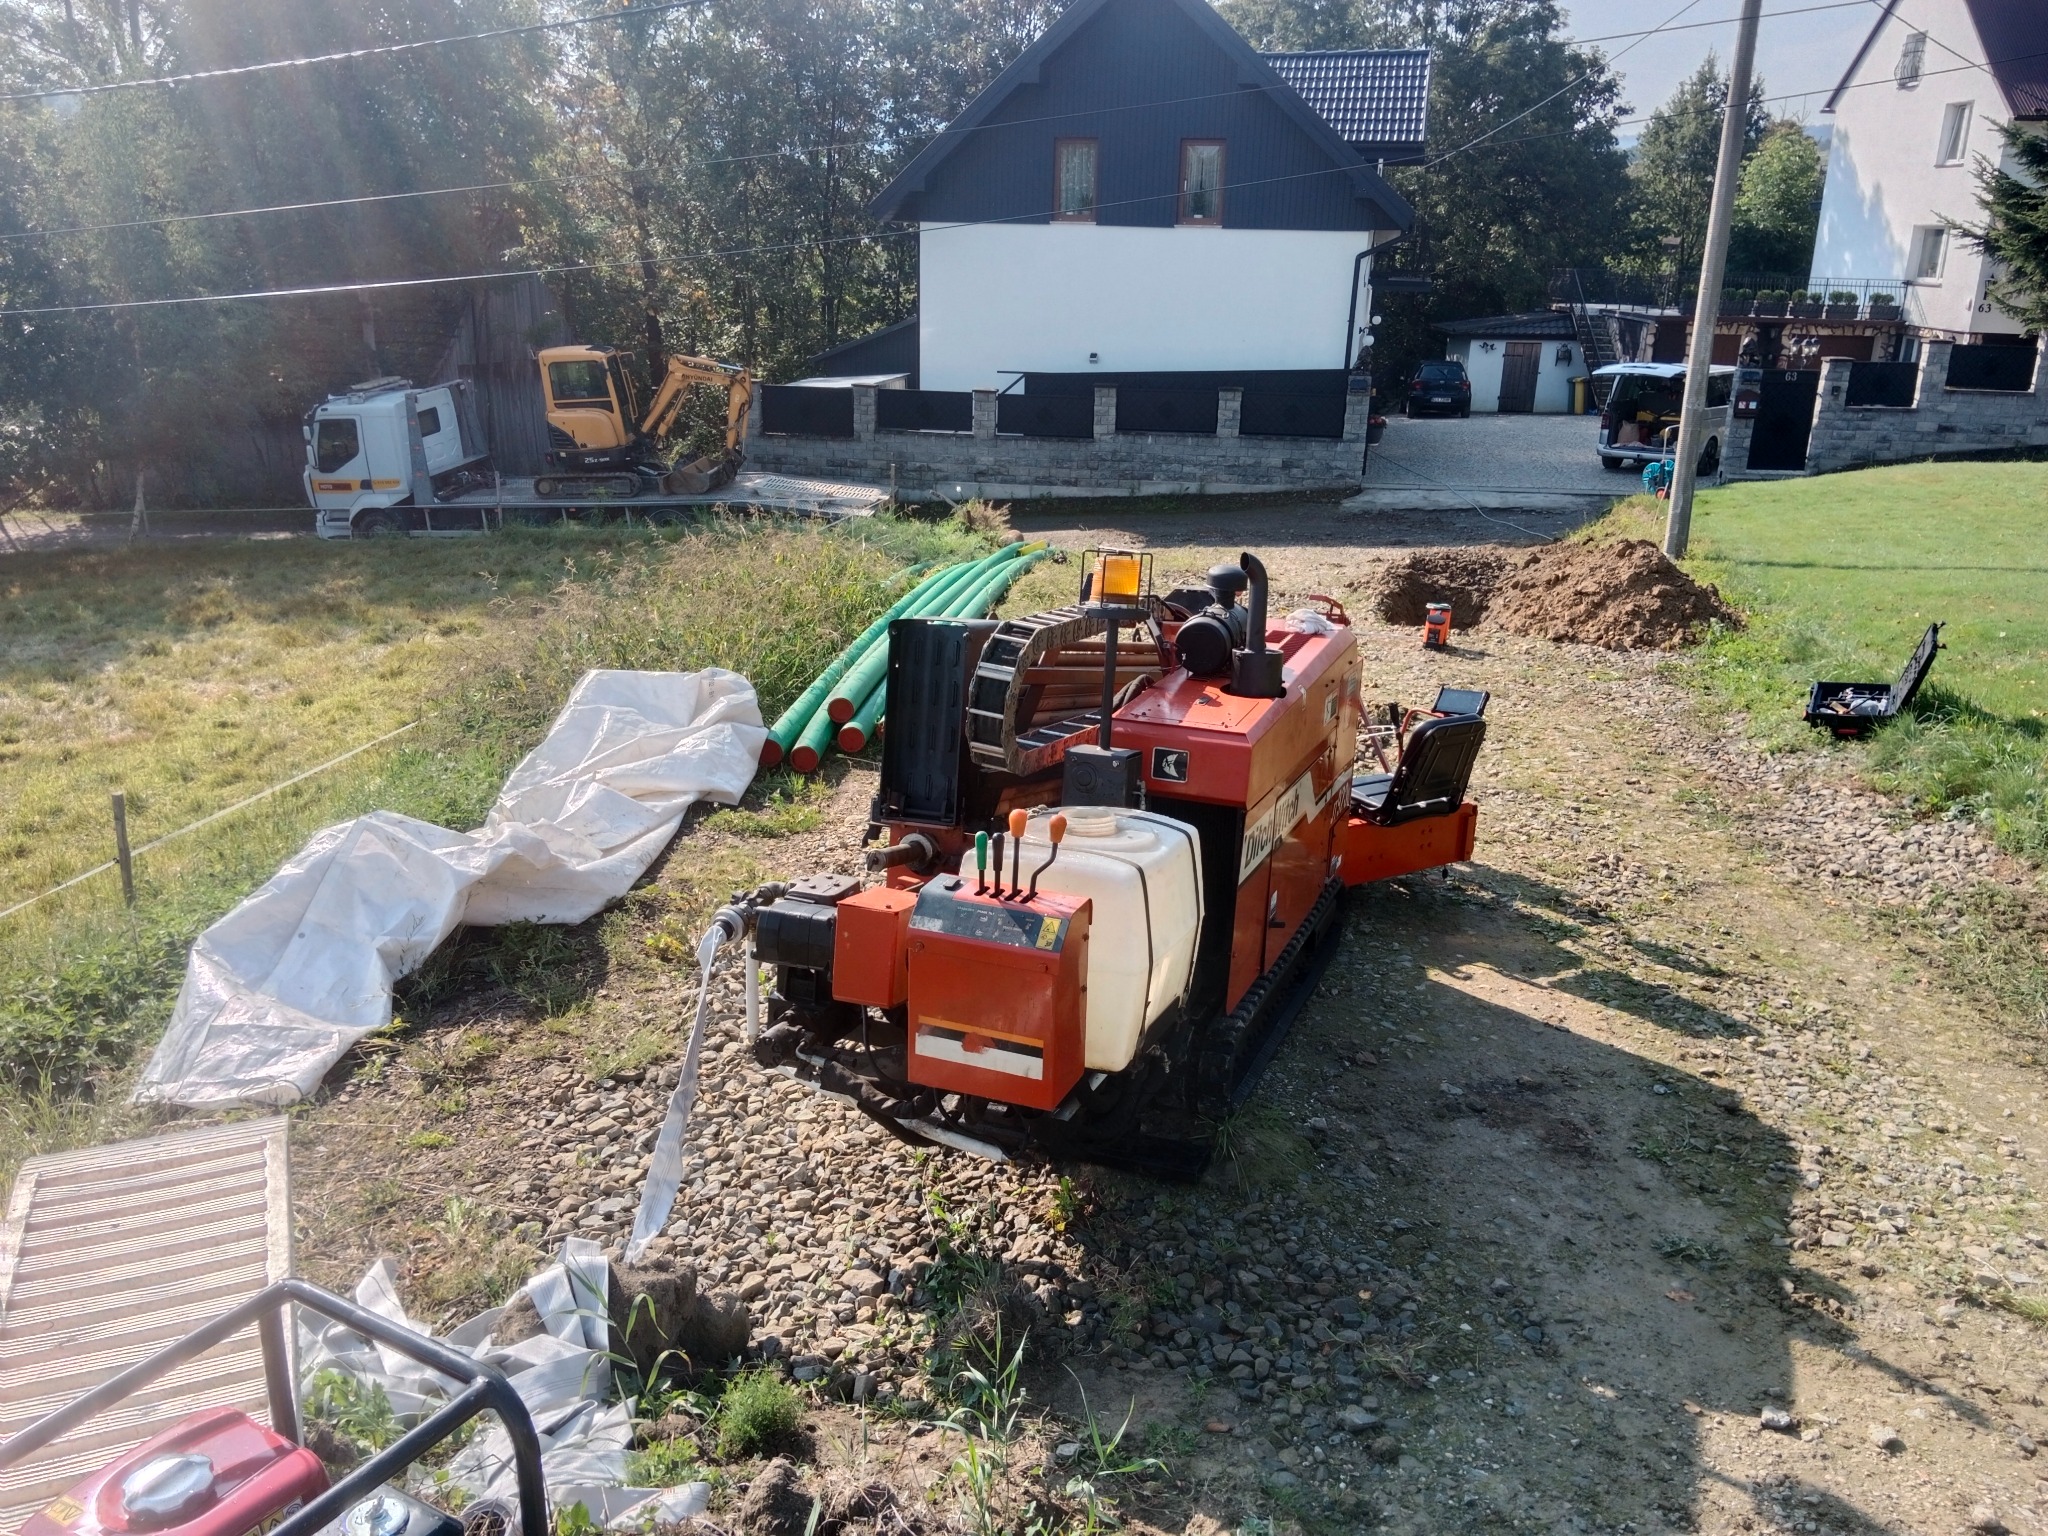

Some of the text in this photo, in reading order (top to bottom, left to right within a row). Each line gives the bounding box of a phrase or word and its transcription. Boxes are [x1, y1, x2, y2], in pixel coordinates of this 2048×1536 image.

[1978, 303, 1992, 313] 63
[685, 374, 713, 382] HYUNDAI
[1785, 371, 1798, 382] 63
[1244, 813, 1273, 870] Ditch
